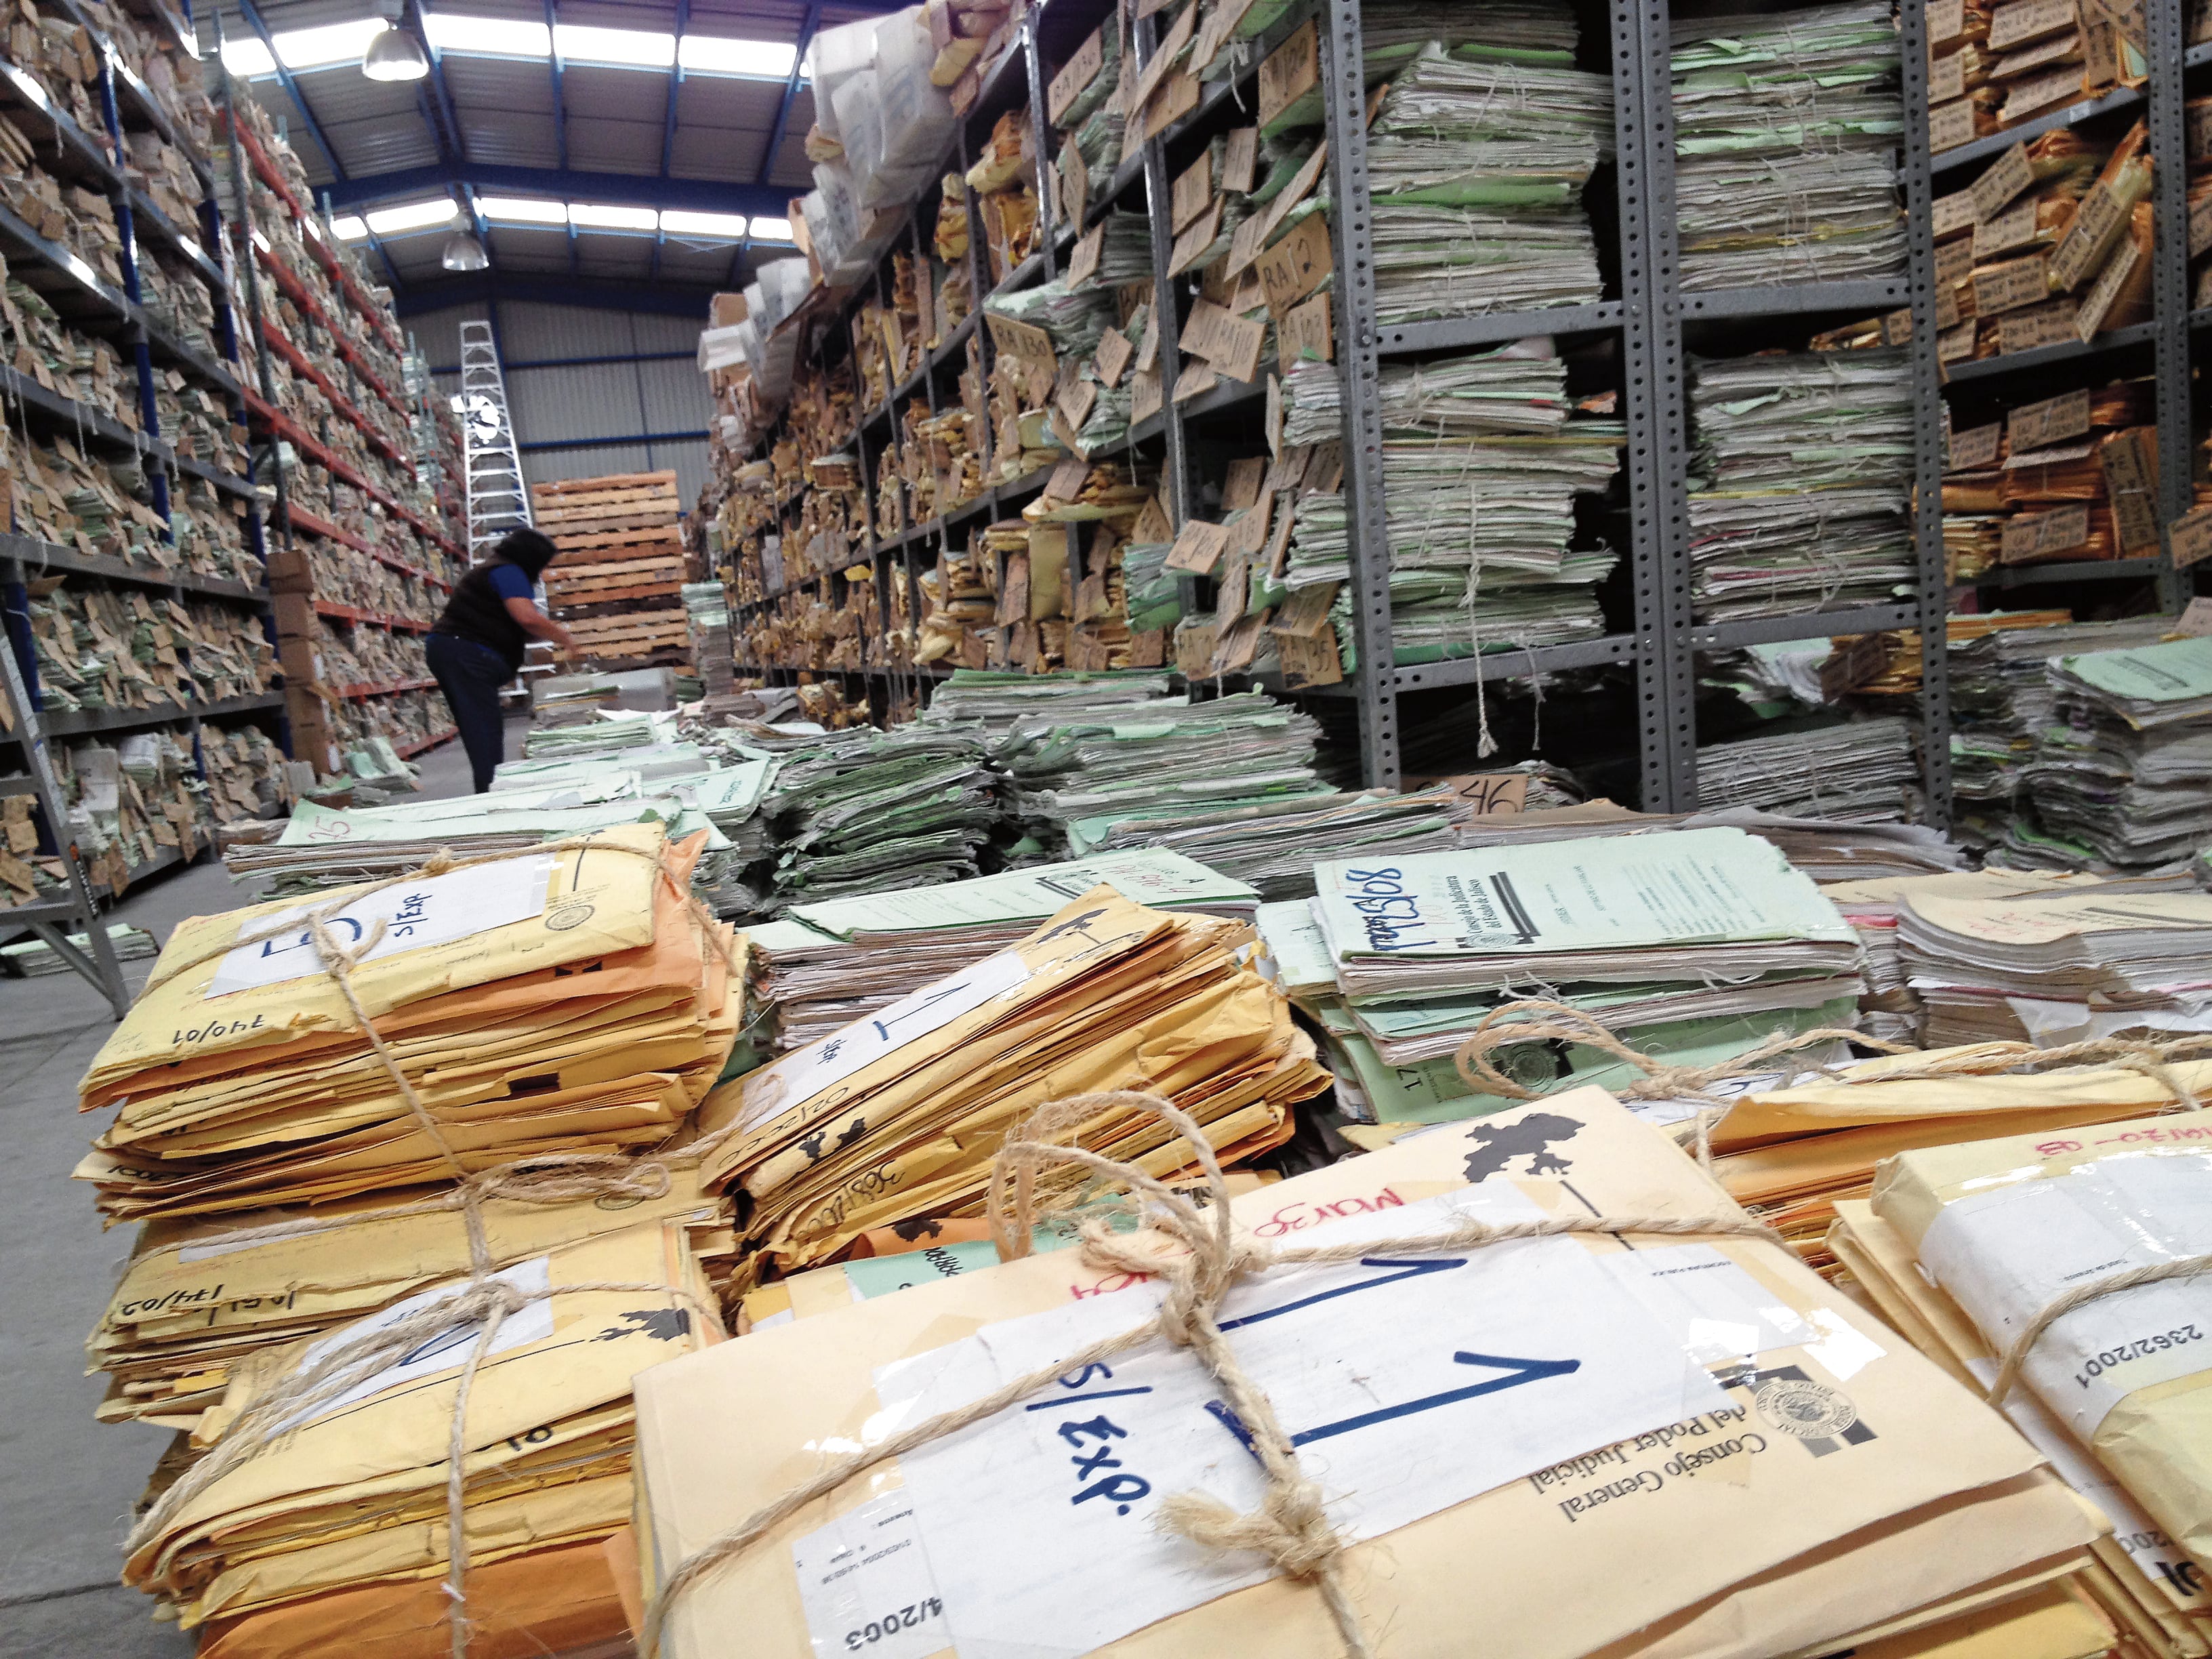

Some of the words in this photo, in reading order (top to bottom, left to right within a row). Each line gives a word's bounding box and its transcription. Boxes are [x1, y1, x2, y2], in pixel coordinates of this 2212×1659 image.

[1263, 261, 1291, 289] RA
[172, 1014, 266, 1044] 740/01
[1396, 1067, 1423, 1091] 17
[2074, 1324, 2205, 1389] 2362/2001
[1714, 1403, 1747, 1432] del
[1635, 1418, 1710, 1453] Poder
[1527, 1442, 1629, 1496] Judicial
[1664, 1433, 1767, 1478] Consejo
[1557, 1469, 1664, 1523] General
